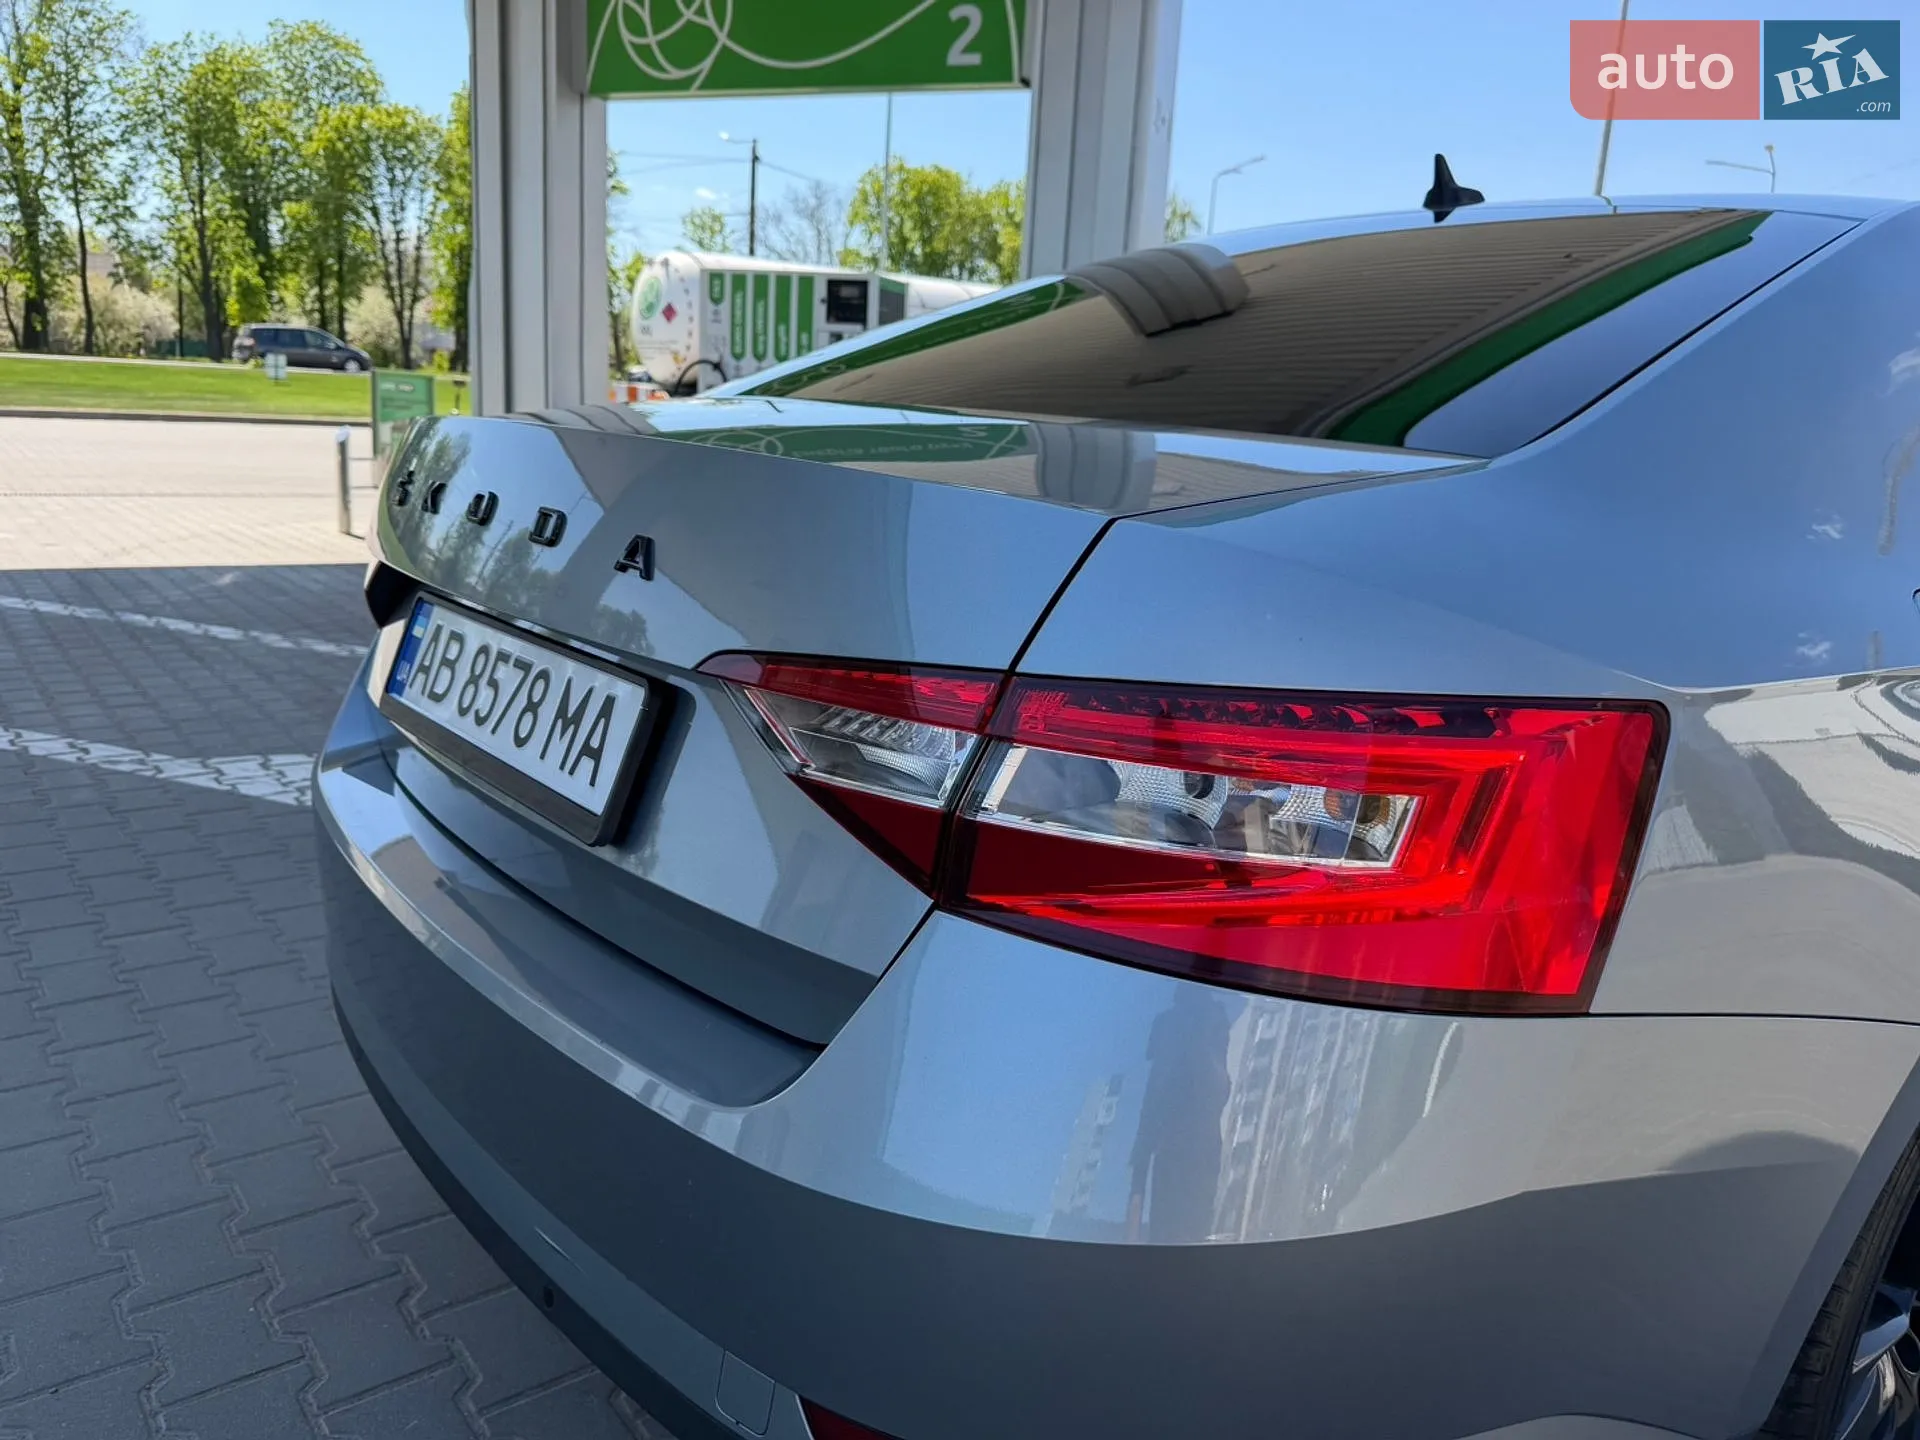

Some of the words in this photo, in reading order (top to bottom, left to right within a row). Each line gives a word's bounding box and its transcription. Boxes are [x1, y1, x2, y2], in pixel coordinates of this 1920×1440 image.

[945, 4, 983, 66] 2
[409, 624, 466, 702] AB
[457, 644, 551, 749] 8578
[539, 676, 617, 788] MA
